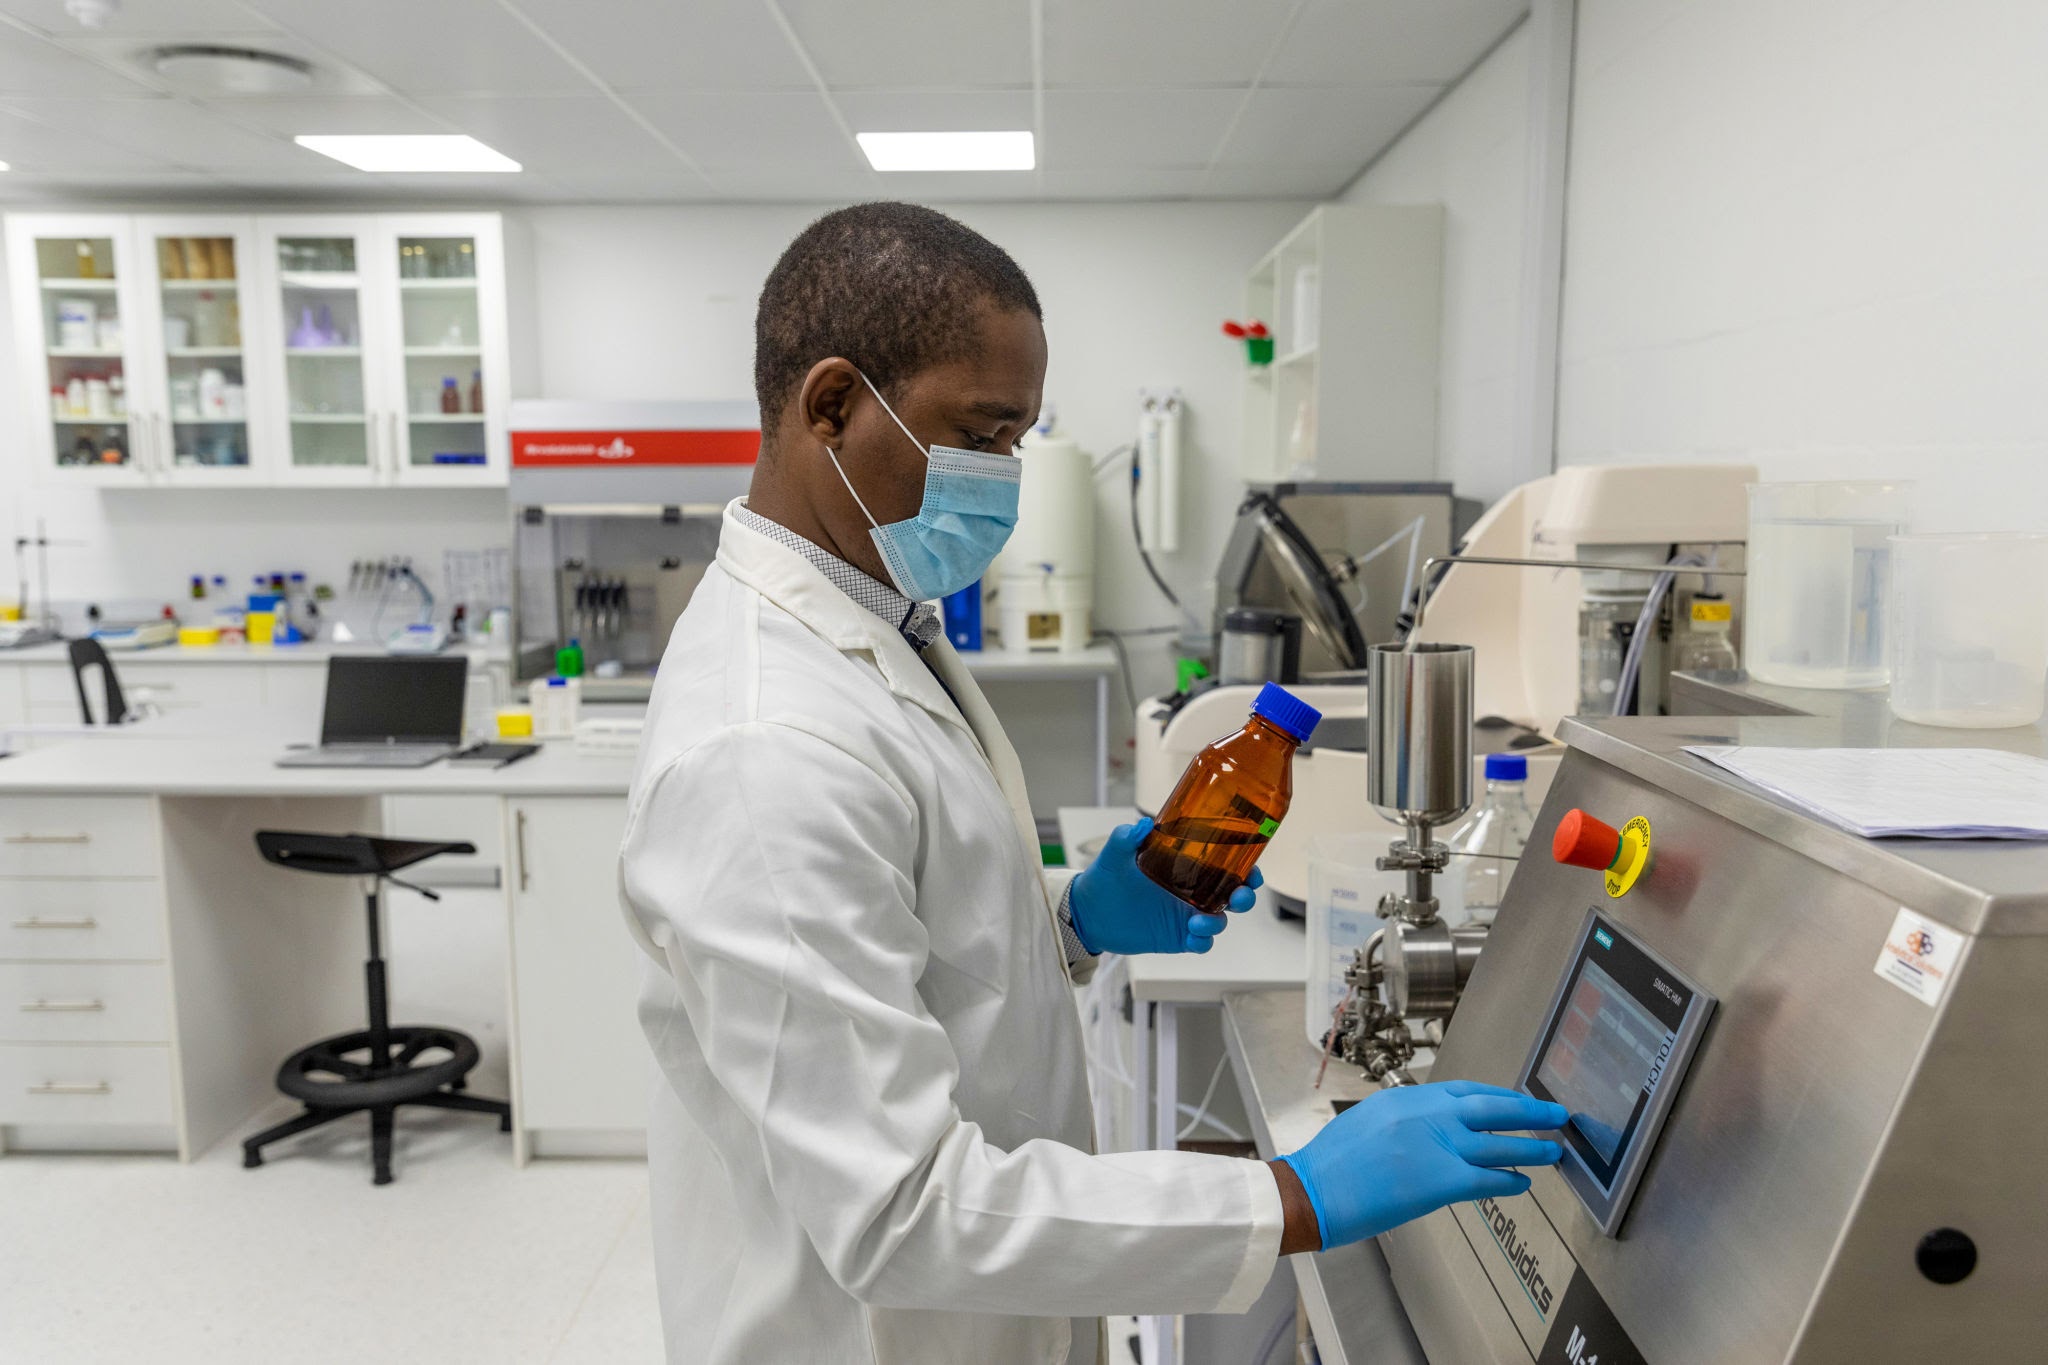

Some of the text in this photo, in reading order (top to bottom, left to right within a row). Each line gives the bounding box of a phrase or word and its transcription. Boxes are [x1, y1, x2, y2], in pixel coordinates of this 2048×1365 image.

[1622, 818, 1649, 848] EMERGENCY
[1606, 878, 1621, 895] STOP
[1595, 930, 1612, 948] SIEMENS
[1652, 977, 1682, 1007] SIMATIC HMI
[1644, 1035, 1676, 1094] TOUCH
